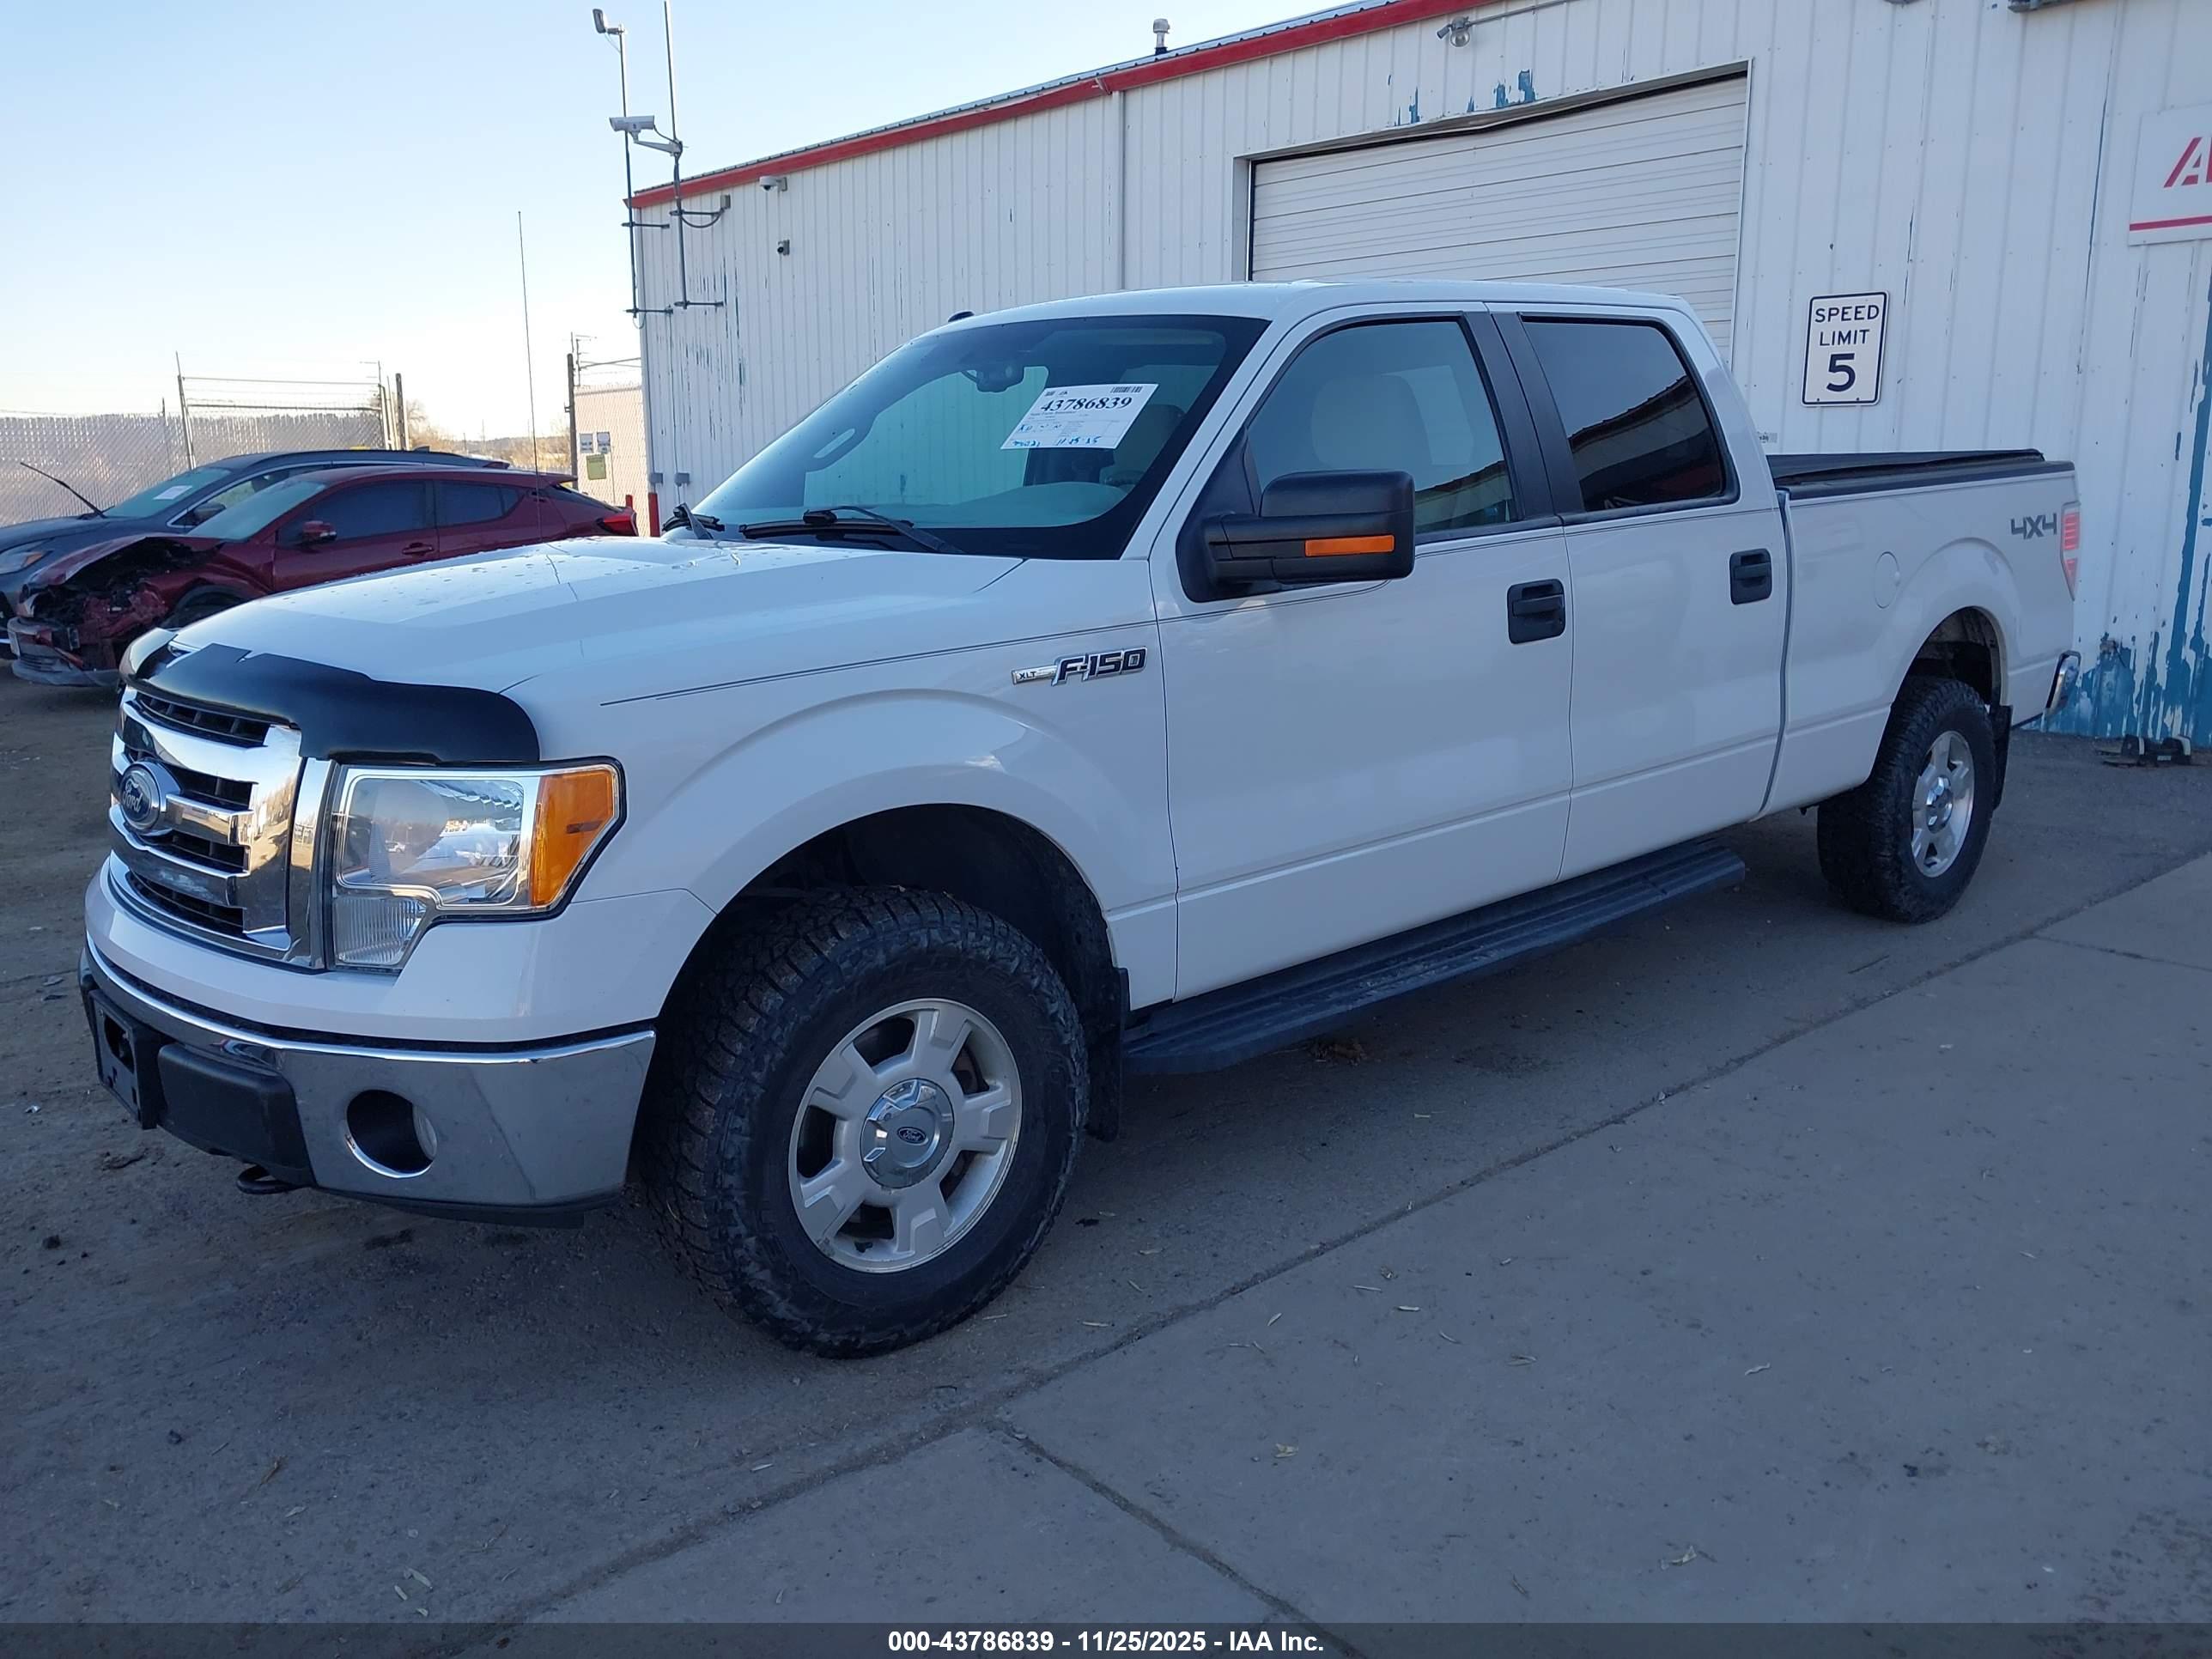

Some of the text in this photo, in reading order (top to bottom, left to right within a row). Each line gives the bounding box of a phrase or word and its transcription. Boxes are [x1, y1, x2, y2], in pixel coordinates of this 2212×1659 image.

[1814, 304, 1880, 323] SPEED
[1819, 329, 1870, 346] LIMIT
[1826, 353, 1856, 392] 5
[1041, 397, 1133, 411] 43786839
[1019, 646, 1147, 686] XLT F-150
[123, 777, 144, 813] Ford
